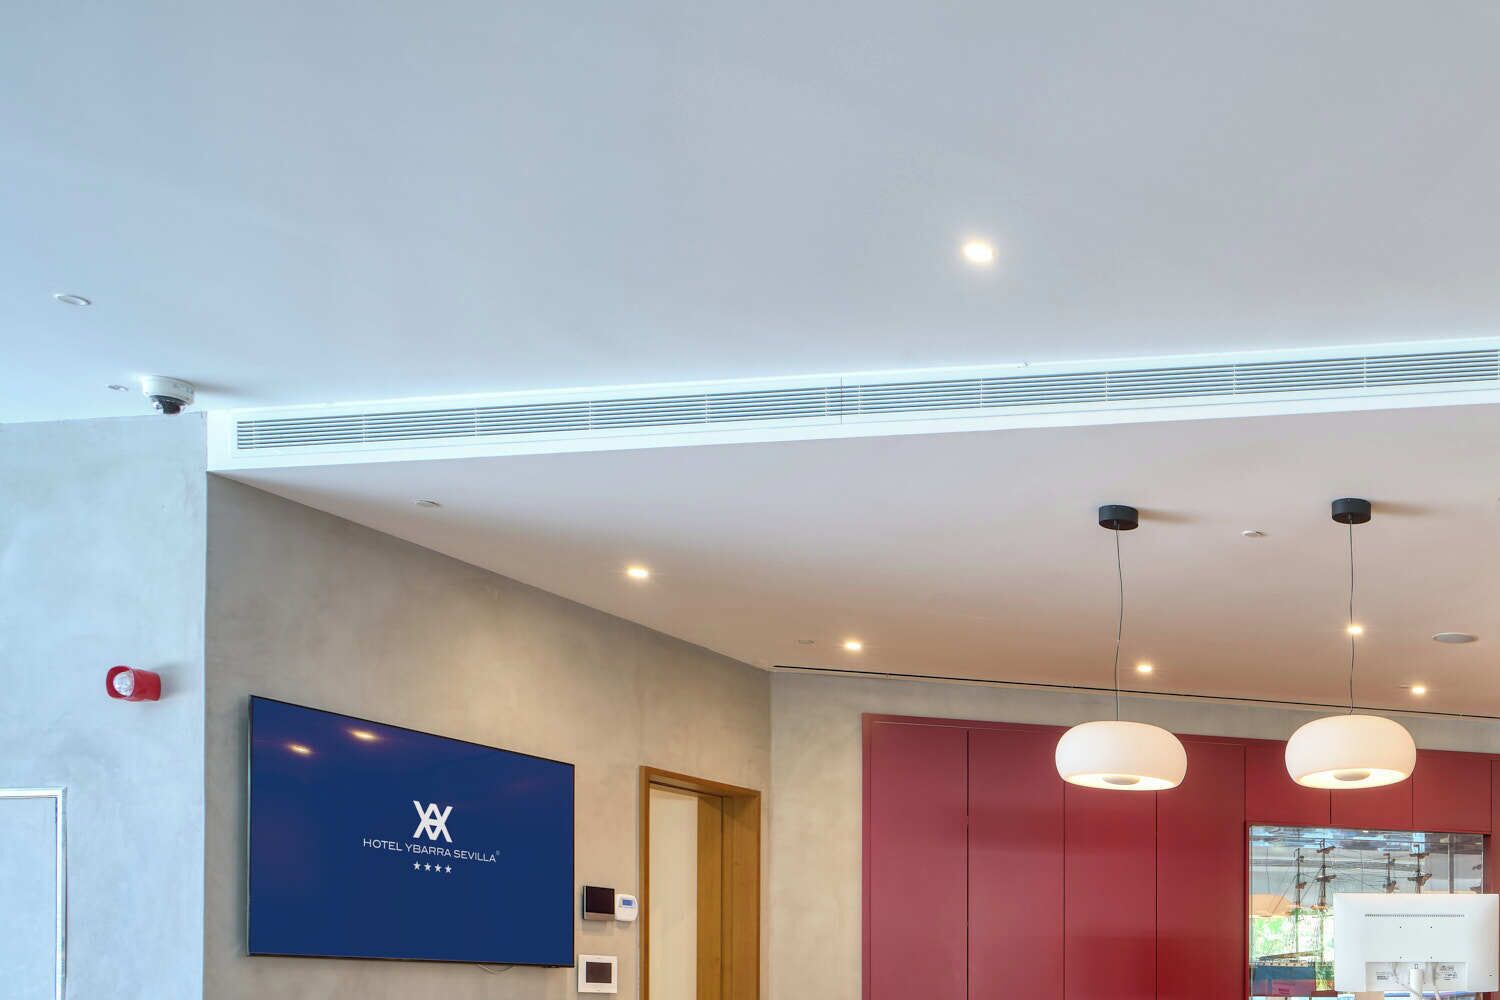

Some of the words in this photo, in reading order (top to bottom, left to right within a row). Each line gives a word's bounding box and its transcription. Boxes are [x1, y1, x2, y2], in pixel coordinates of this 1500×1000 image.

[363, 838, 403, 851] HOTEL
[405, 843, 452, 857] YBARRA
[454, 849, 497, 863] SEVILLA
